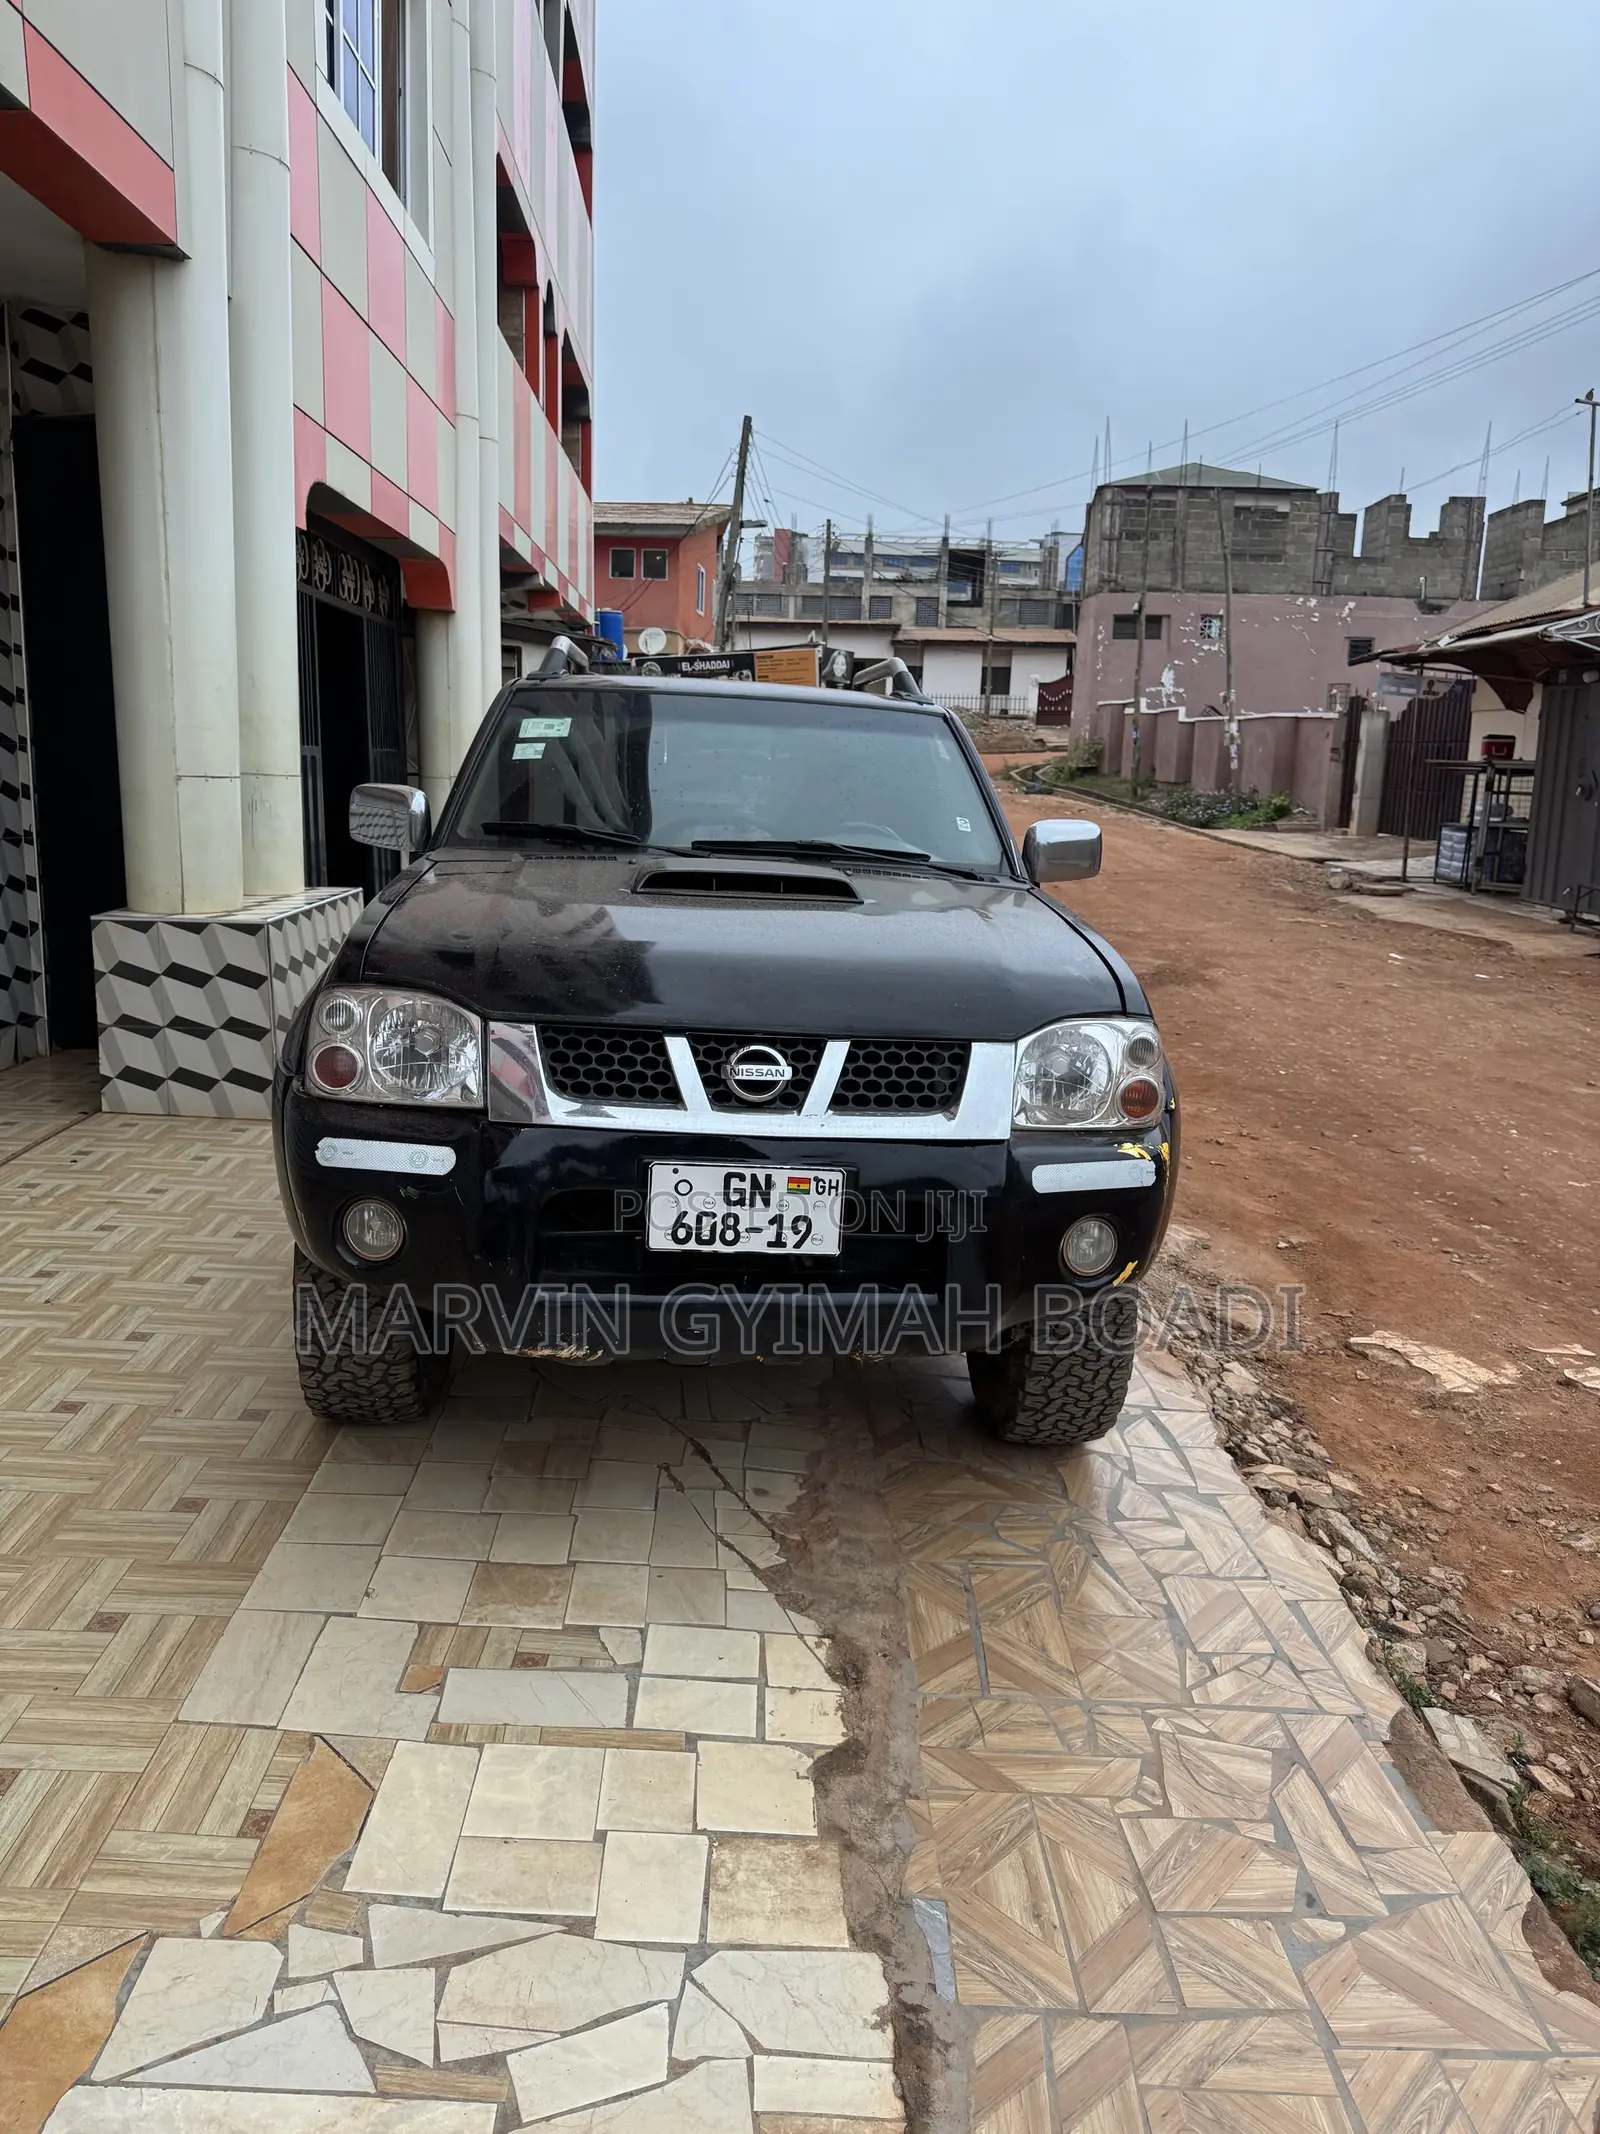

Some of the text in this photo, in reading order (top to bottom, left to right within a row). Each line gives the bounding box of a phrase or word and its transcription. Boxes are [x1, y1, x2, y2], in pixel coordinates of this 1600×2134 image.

[682, 660, 730, 672] EL-SHADDAI
[729, 1067, 785, 1077] NISSAN
[722, 1171, 840, 1208] GN GH
[671, 1210, 812, 1249] 608-19
